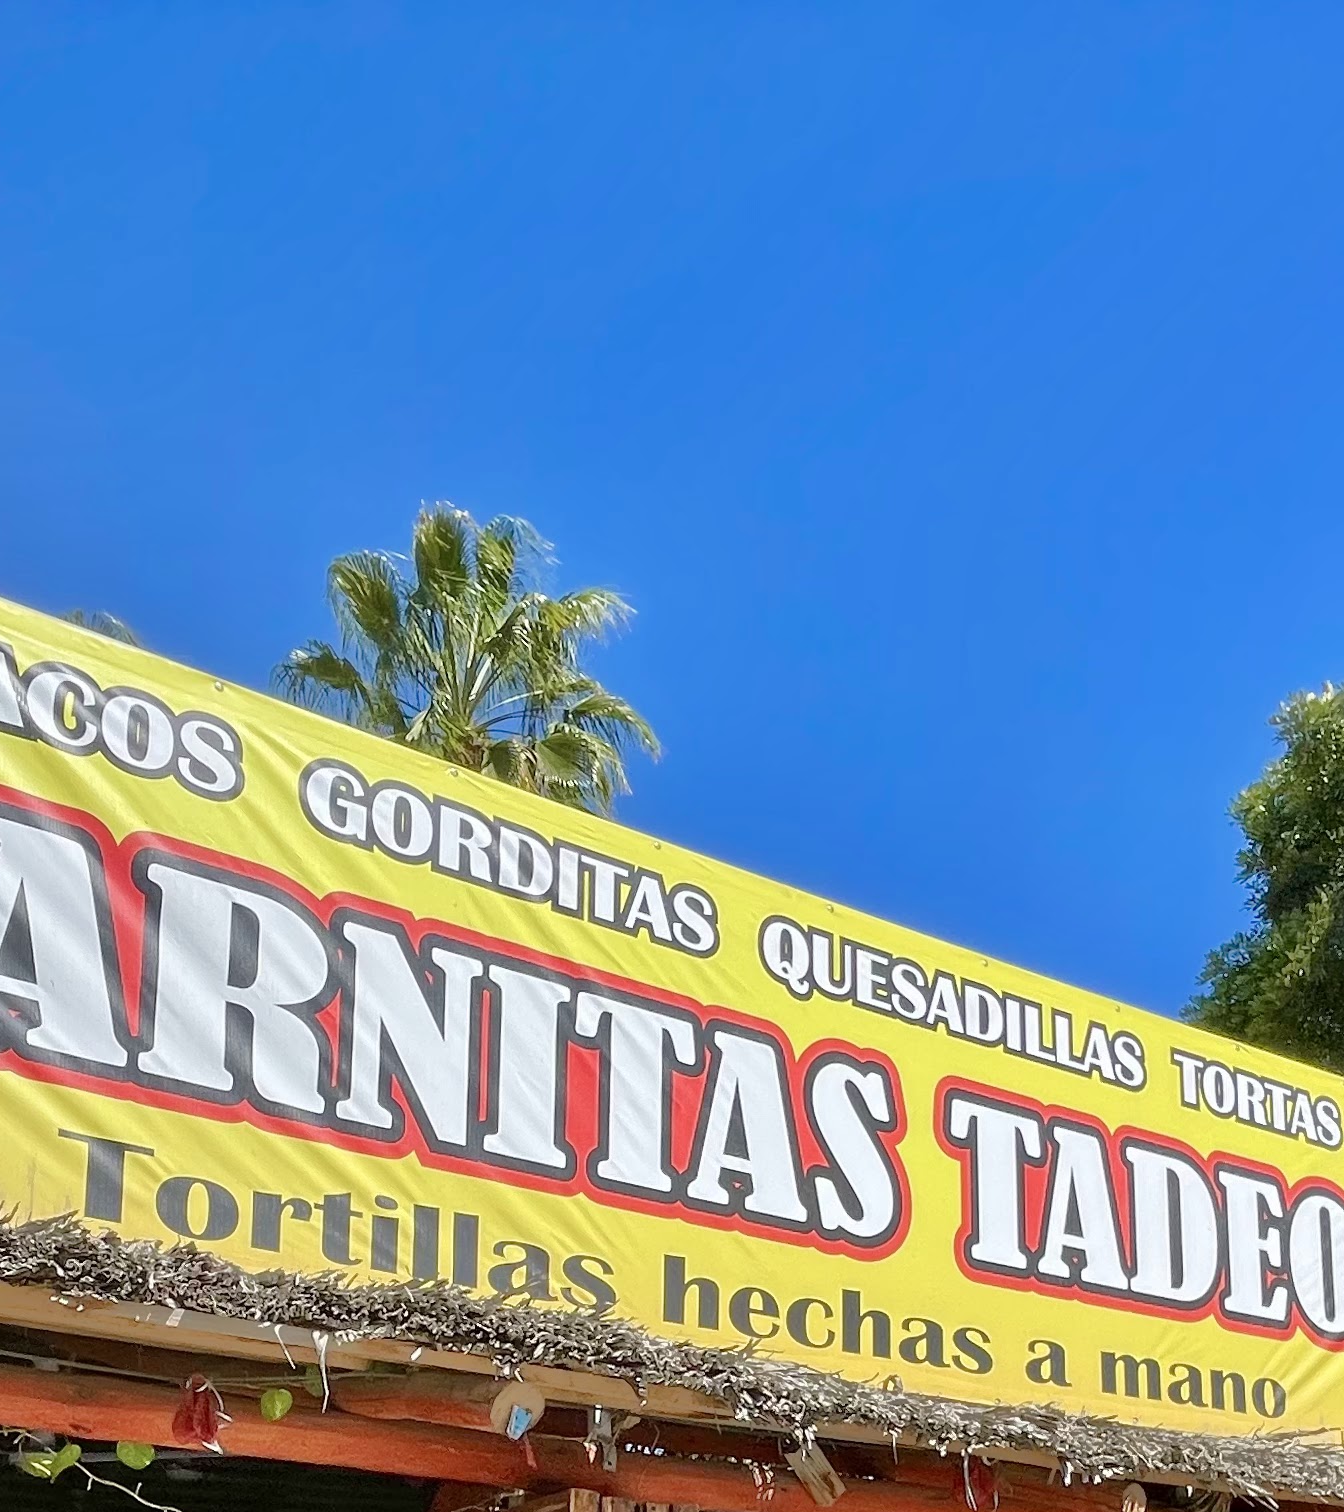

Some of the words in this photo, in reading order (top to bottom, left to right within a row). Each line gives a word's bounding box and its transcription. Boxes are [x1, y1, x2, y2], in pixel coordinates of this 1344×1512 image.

[298, 758, 720, 957] GORDITAS
[758, 914, 1148, 1091] QUESADILLAS
[1171, 1047, 1344, 1149] TORTAS
[57, 1128, 617, 1314] Tortillas
[662, 1254, 993, 1375] hechas
[1025, 1338, 1072, 1387] a
[1100, 1350, 1288, 1419] mano
